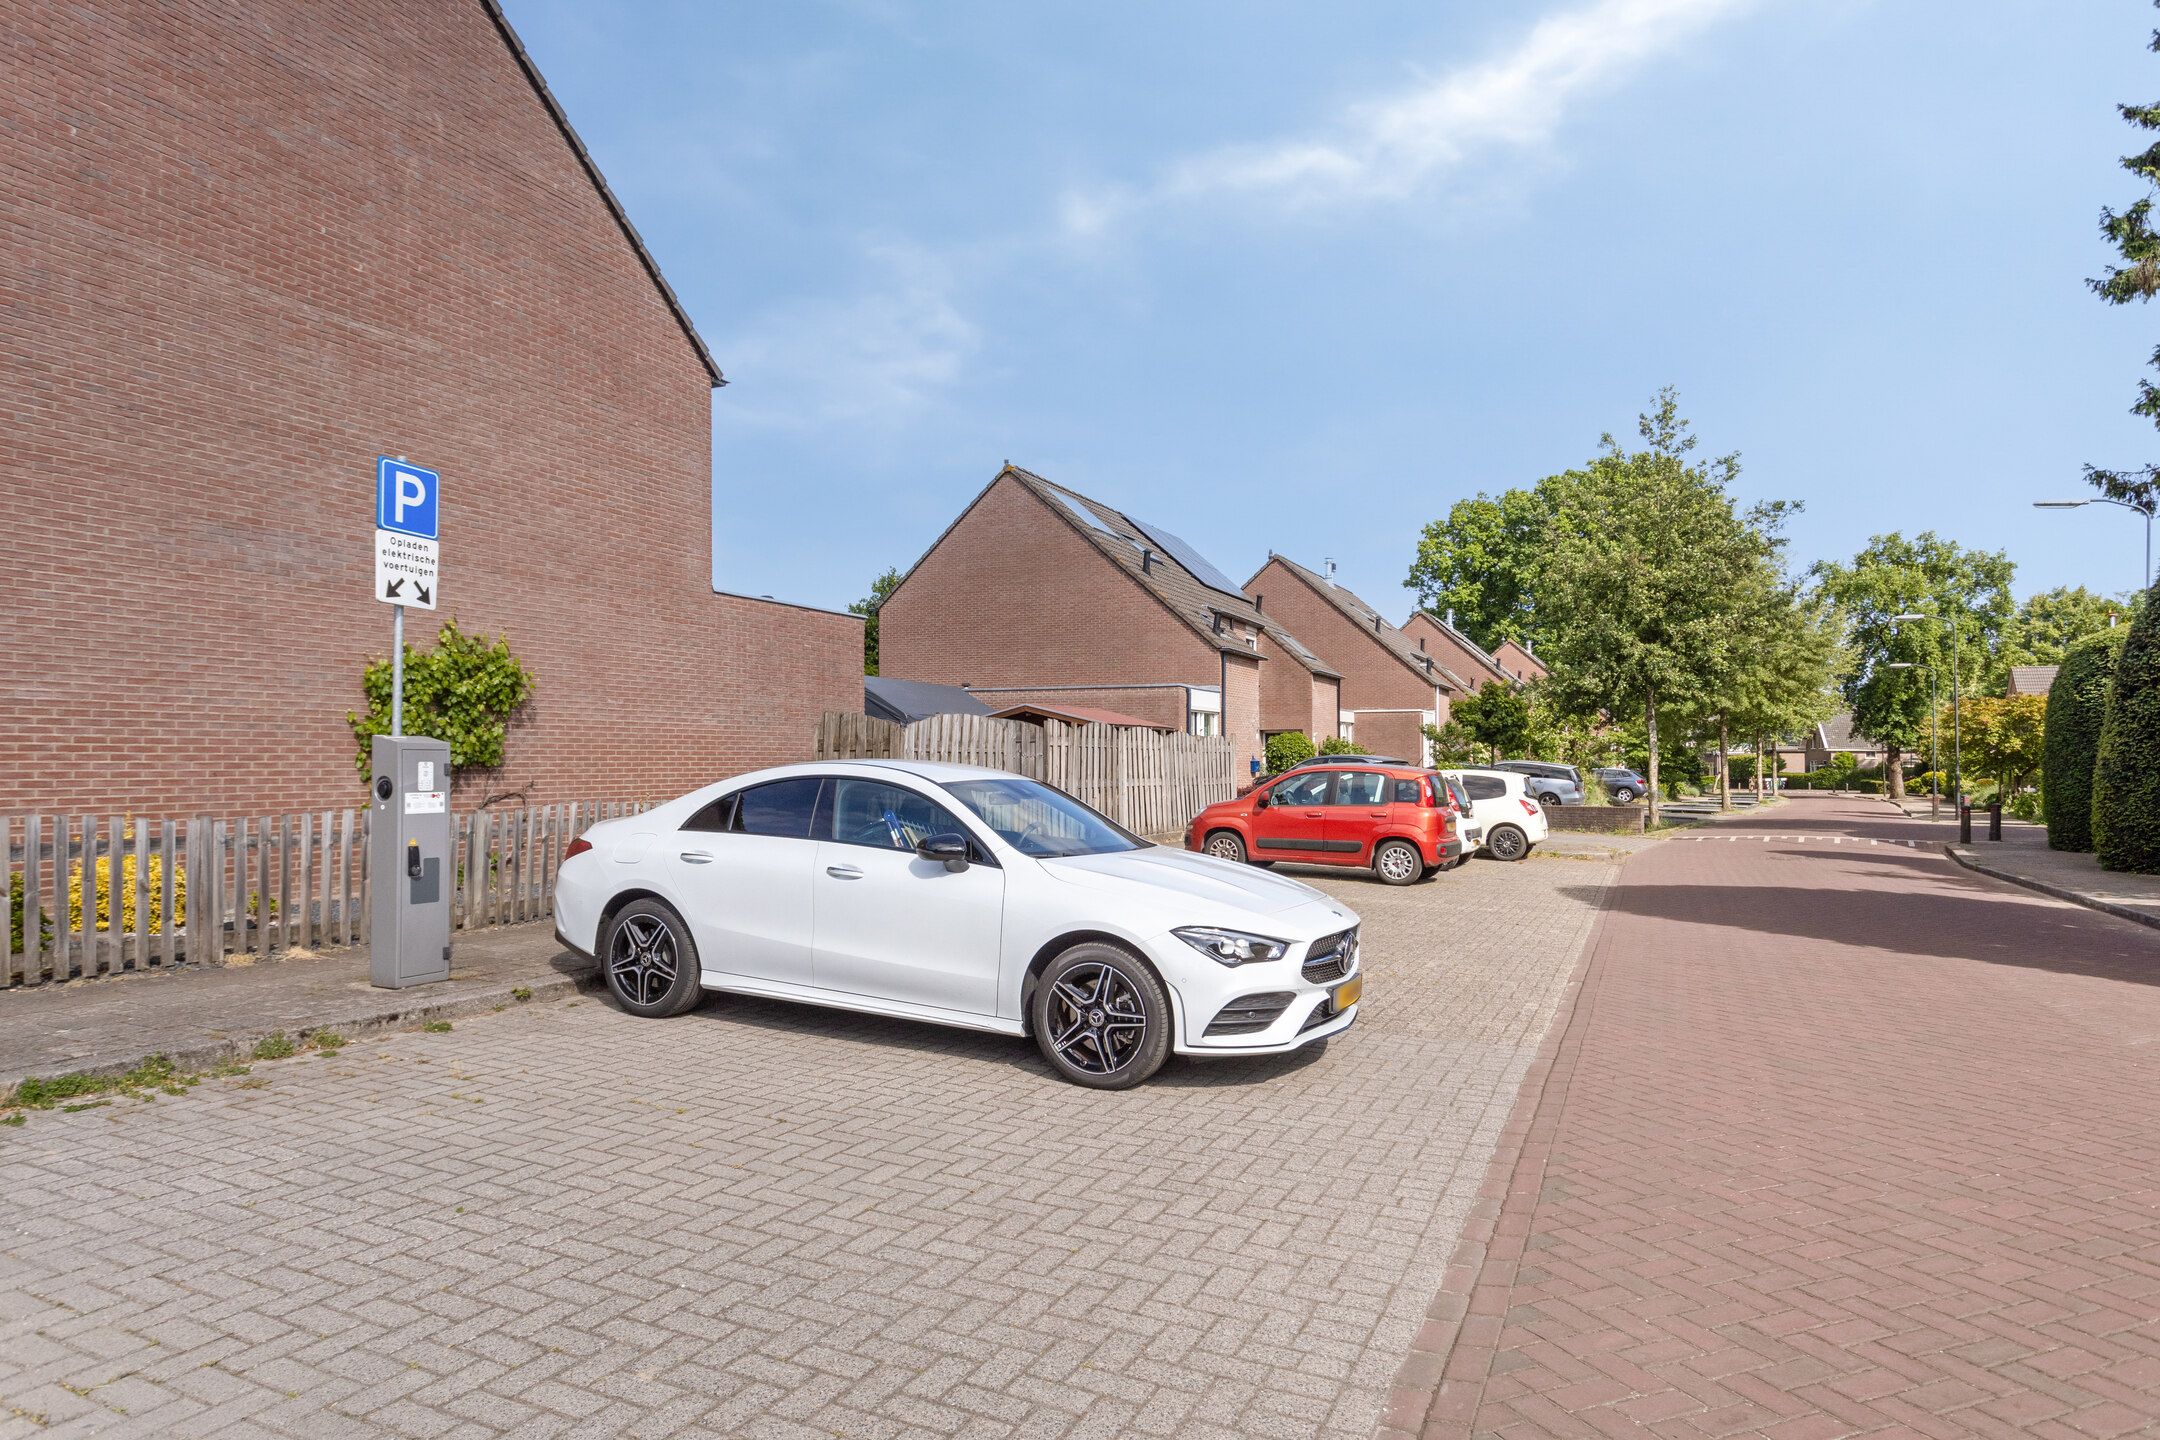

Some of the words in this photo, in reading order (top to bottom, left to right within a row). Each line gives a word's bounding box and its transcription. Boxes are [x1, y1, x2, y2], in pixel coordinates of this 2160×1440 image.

[395, 470, 426, 523] P
[390, 536, 429, 552] Opladen
[382, 549, 436, 566] elektrische
[383, 561, 434, 577] voertuigen
